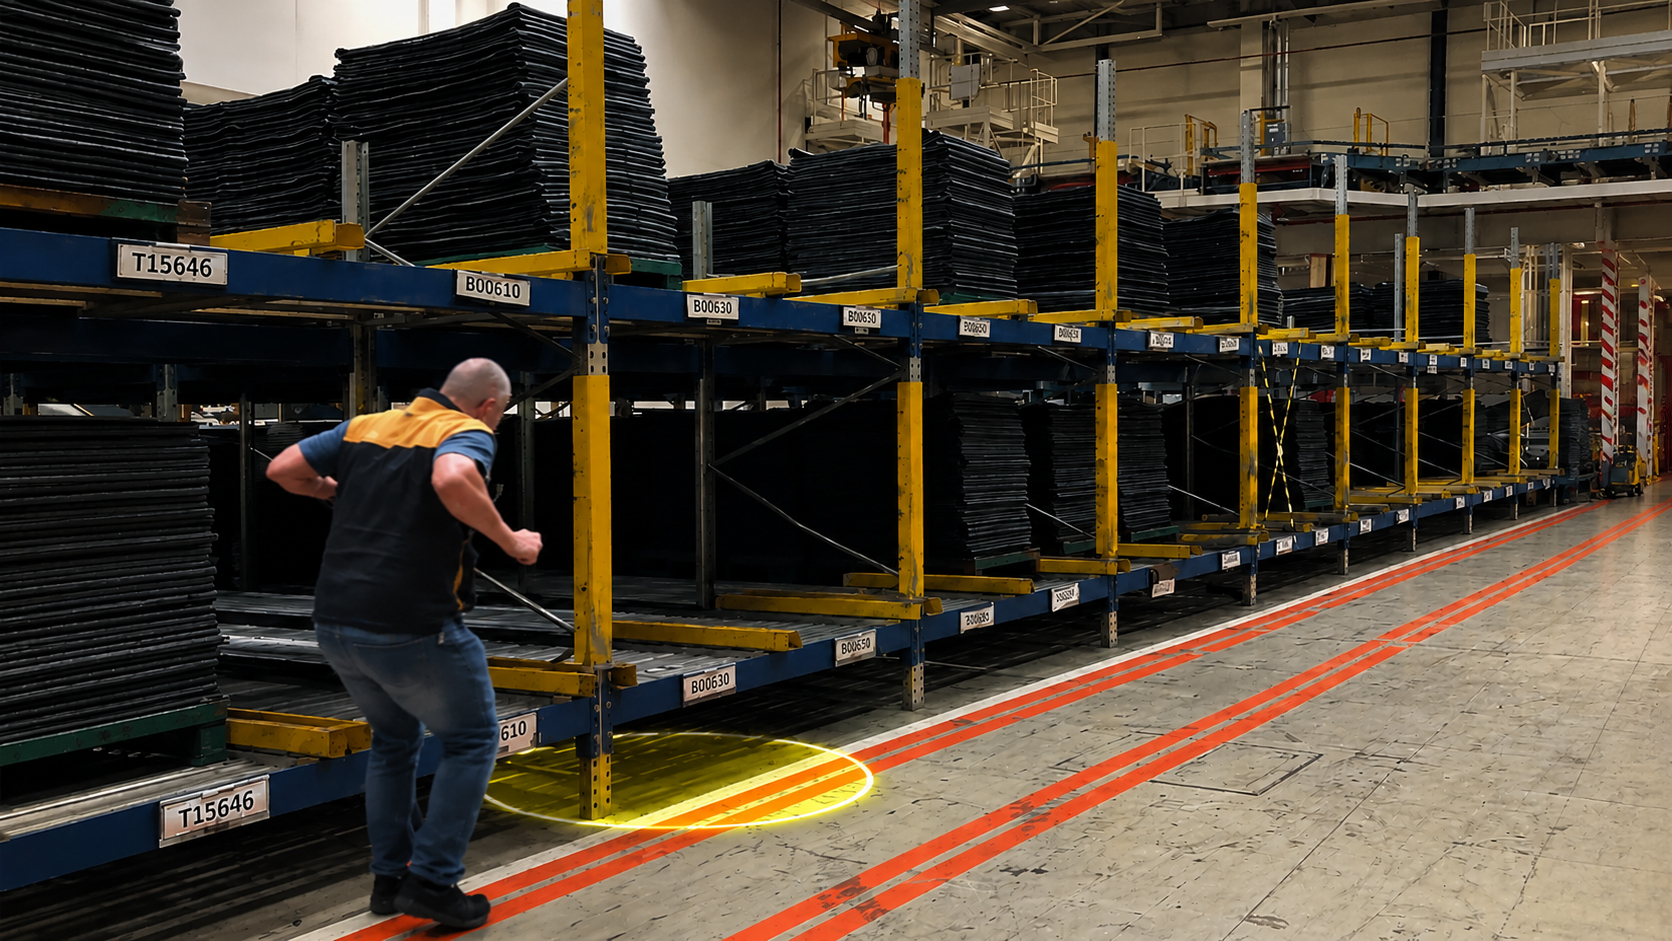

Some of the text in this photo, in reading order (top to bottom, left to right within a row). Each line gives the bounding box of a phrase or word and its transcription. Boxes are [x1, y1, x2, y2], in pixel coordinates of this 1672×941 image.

[132, 252, 212, 278] T15646
[466, 276, 521, 299] B00610
[693, 299, 732, 314] B00630
[691, 672, 730, 695] B00630
[501, 720, 527, 741] 610
[178, 790, 254, 828] T15646
